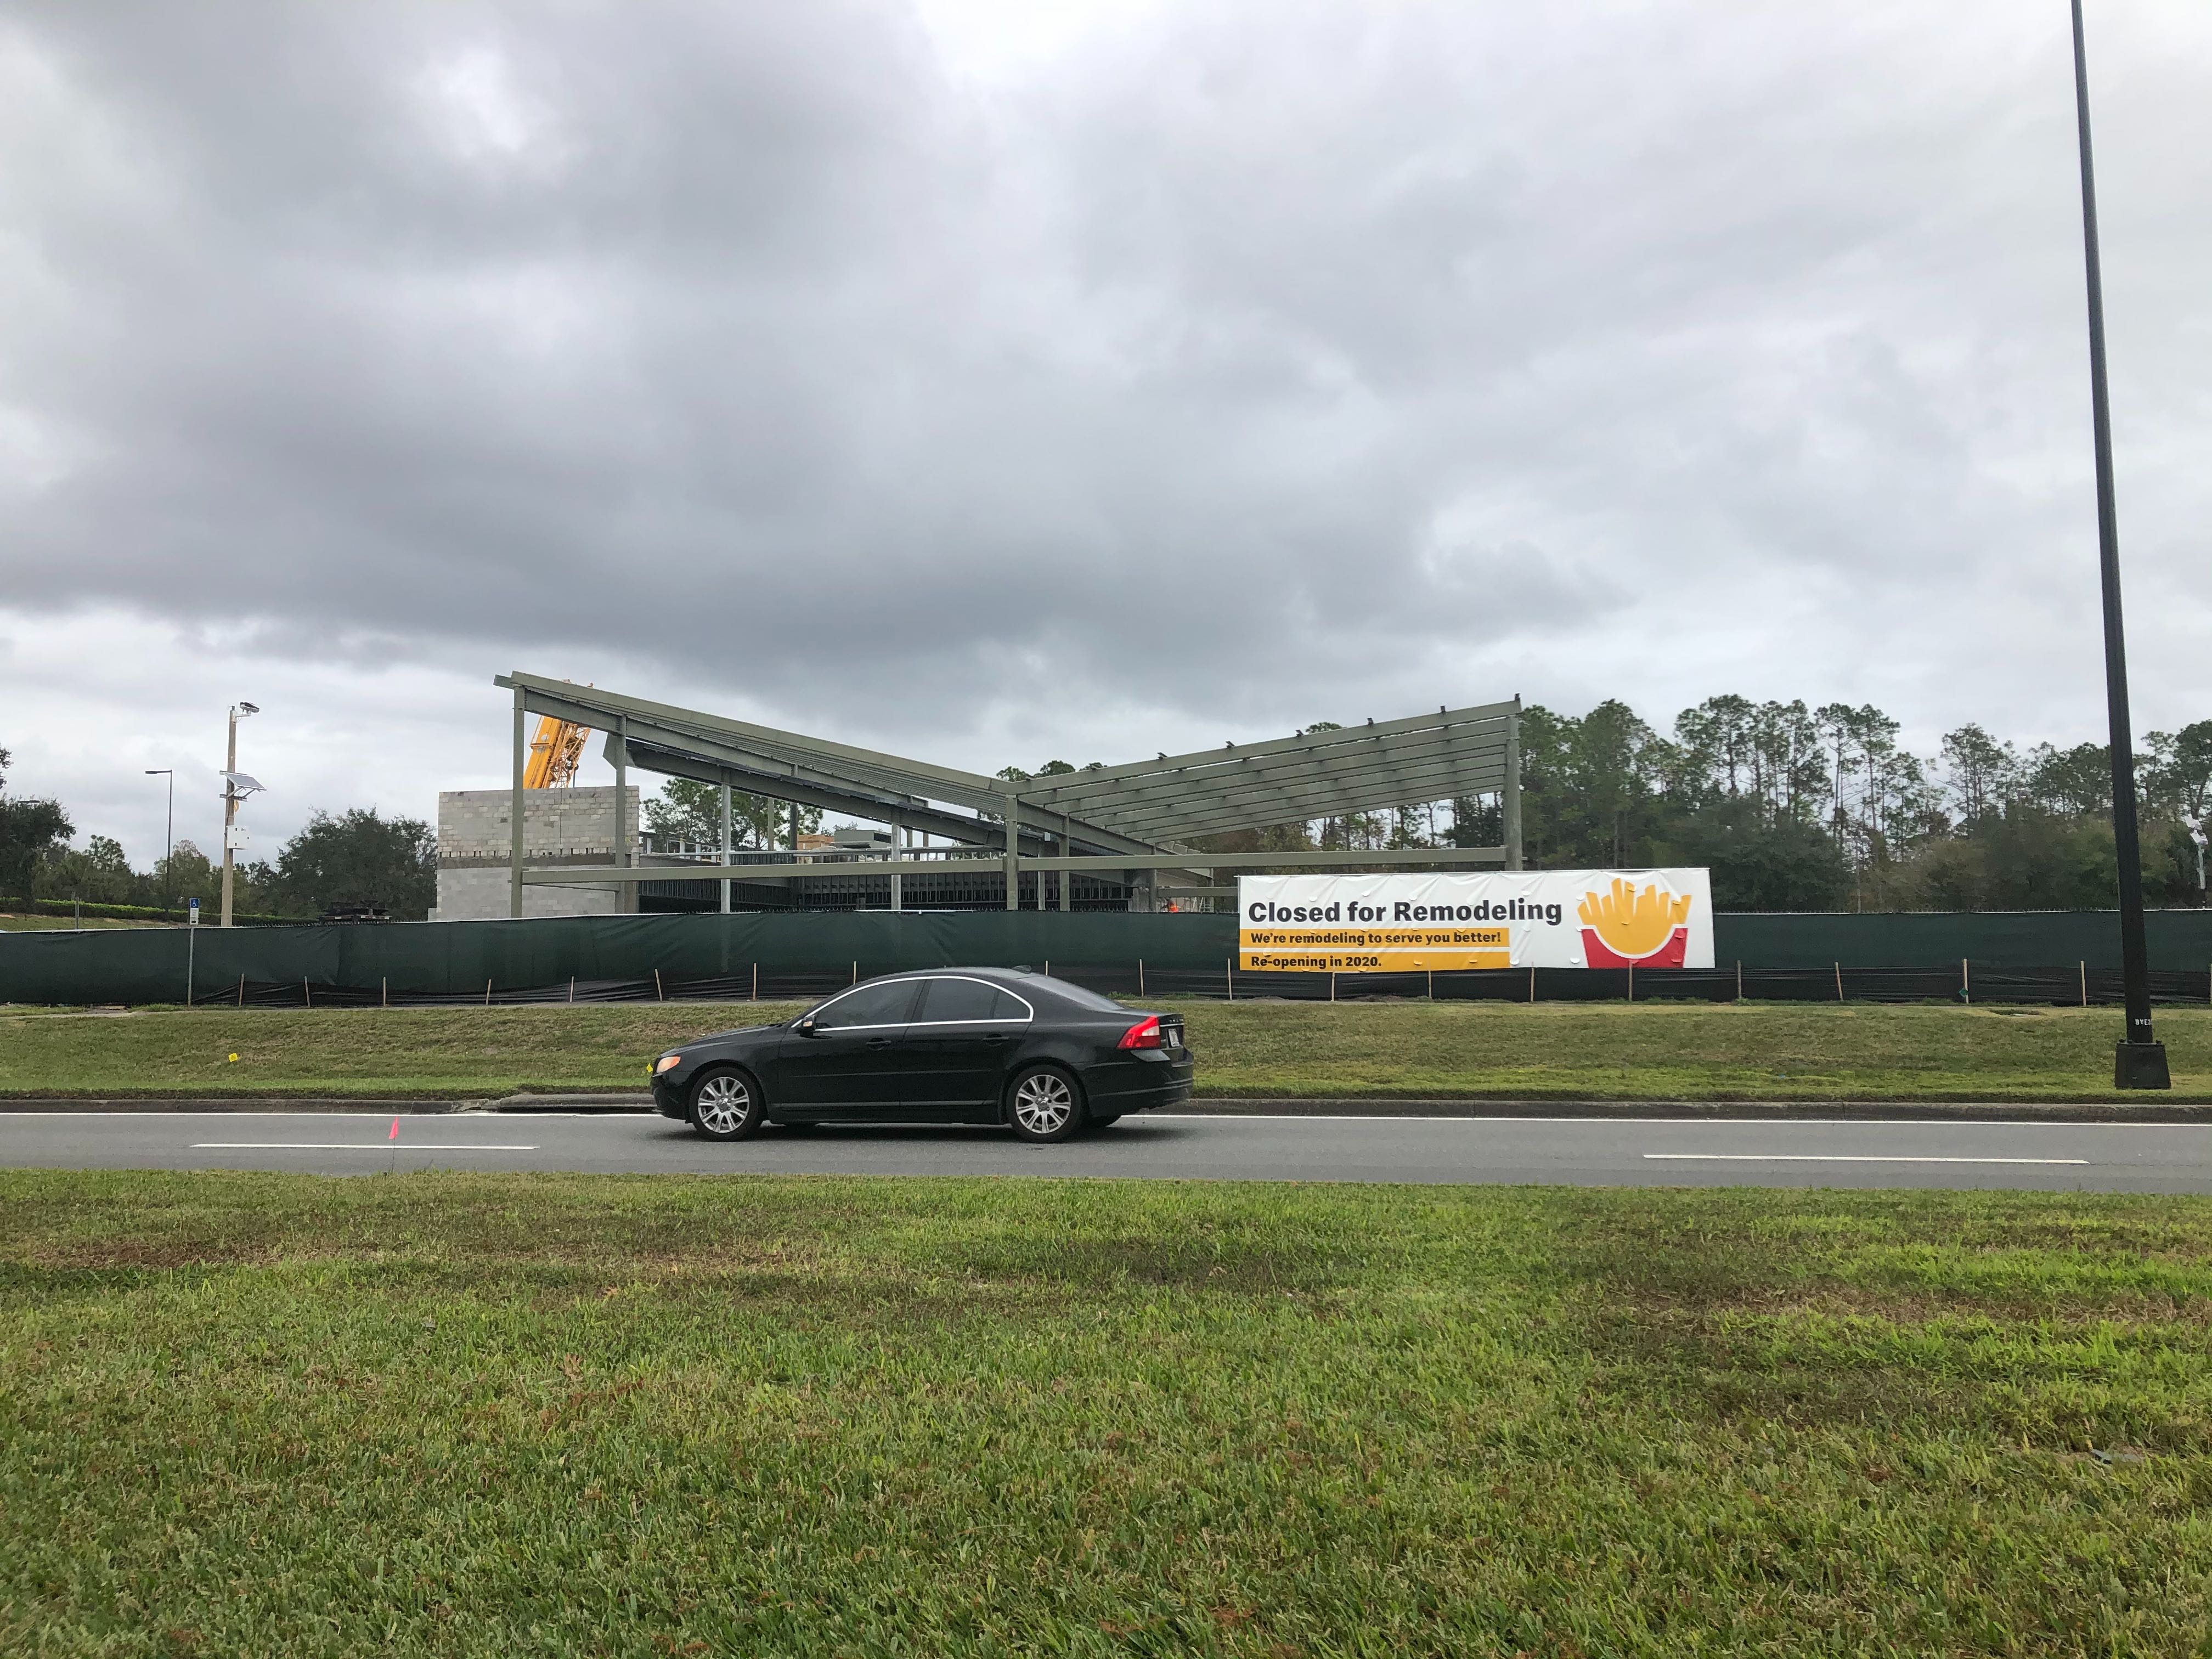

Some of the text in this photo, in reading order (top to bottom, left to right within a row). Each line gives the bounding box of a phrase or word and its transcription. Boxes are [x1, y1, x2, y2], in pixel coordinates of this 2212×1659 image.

[1249, 898, 1562, 926] Closed for Remodeling
[1251, 932, 1501, 946] We’re remodeling to serve you better!
[1251, 955, 1382, 970] Re-opening in 2020.
